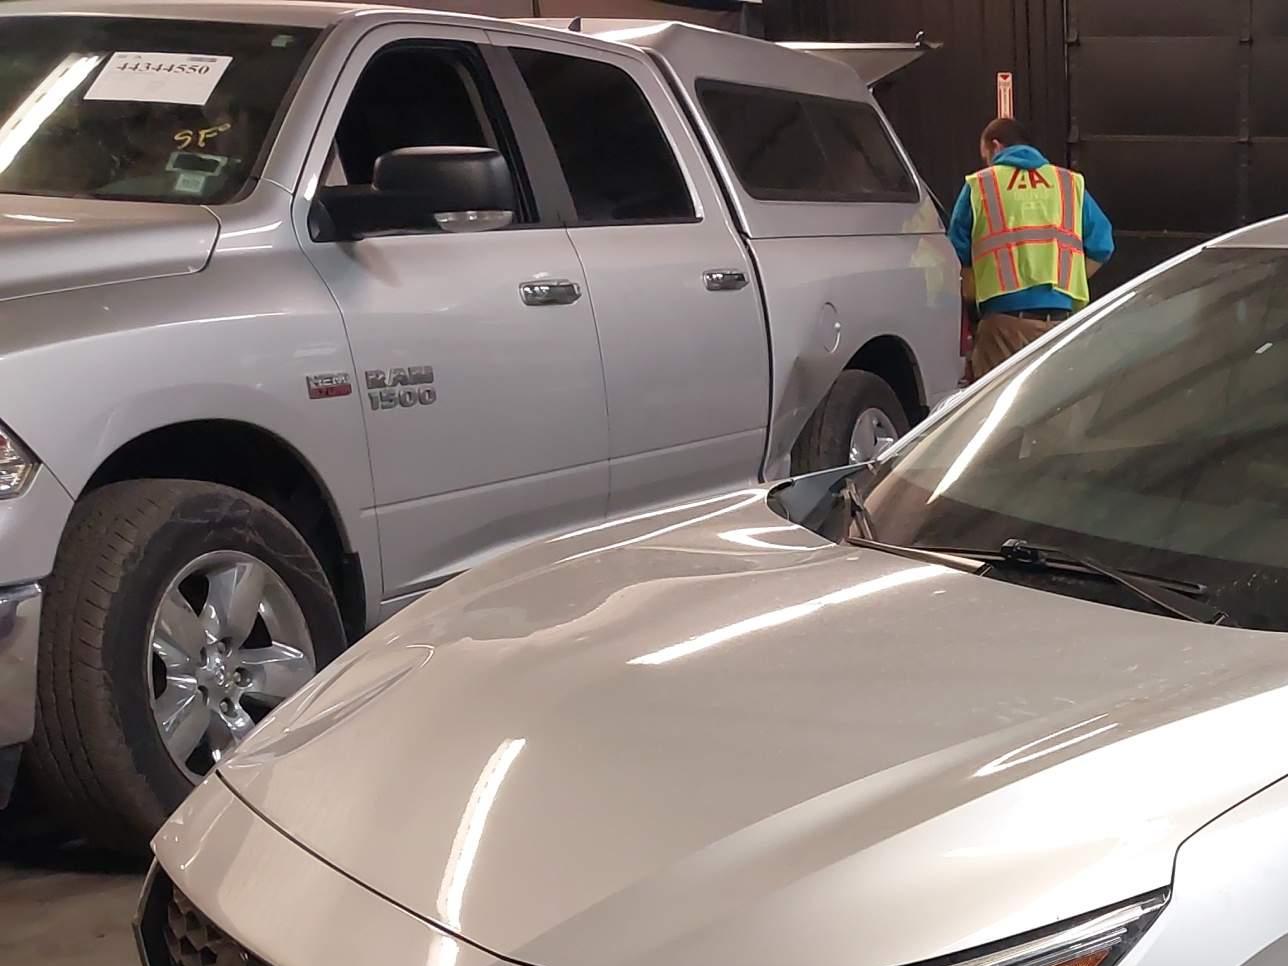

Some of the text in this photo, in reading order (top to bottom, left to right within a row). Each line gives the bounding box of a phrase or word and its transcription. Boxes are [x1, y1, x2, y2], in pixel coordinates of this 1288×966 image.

[116, 62, 211, 75] 44344550
[364, 365, 434, 390] RAM
[367, 386, 437, 411] 1500
